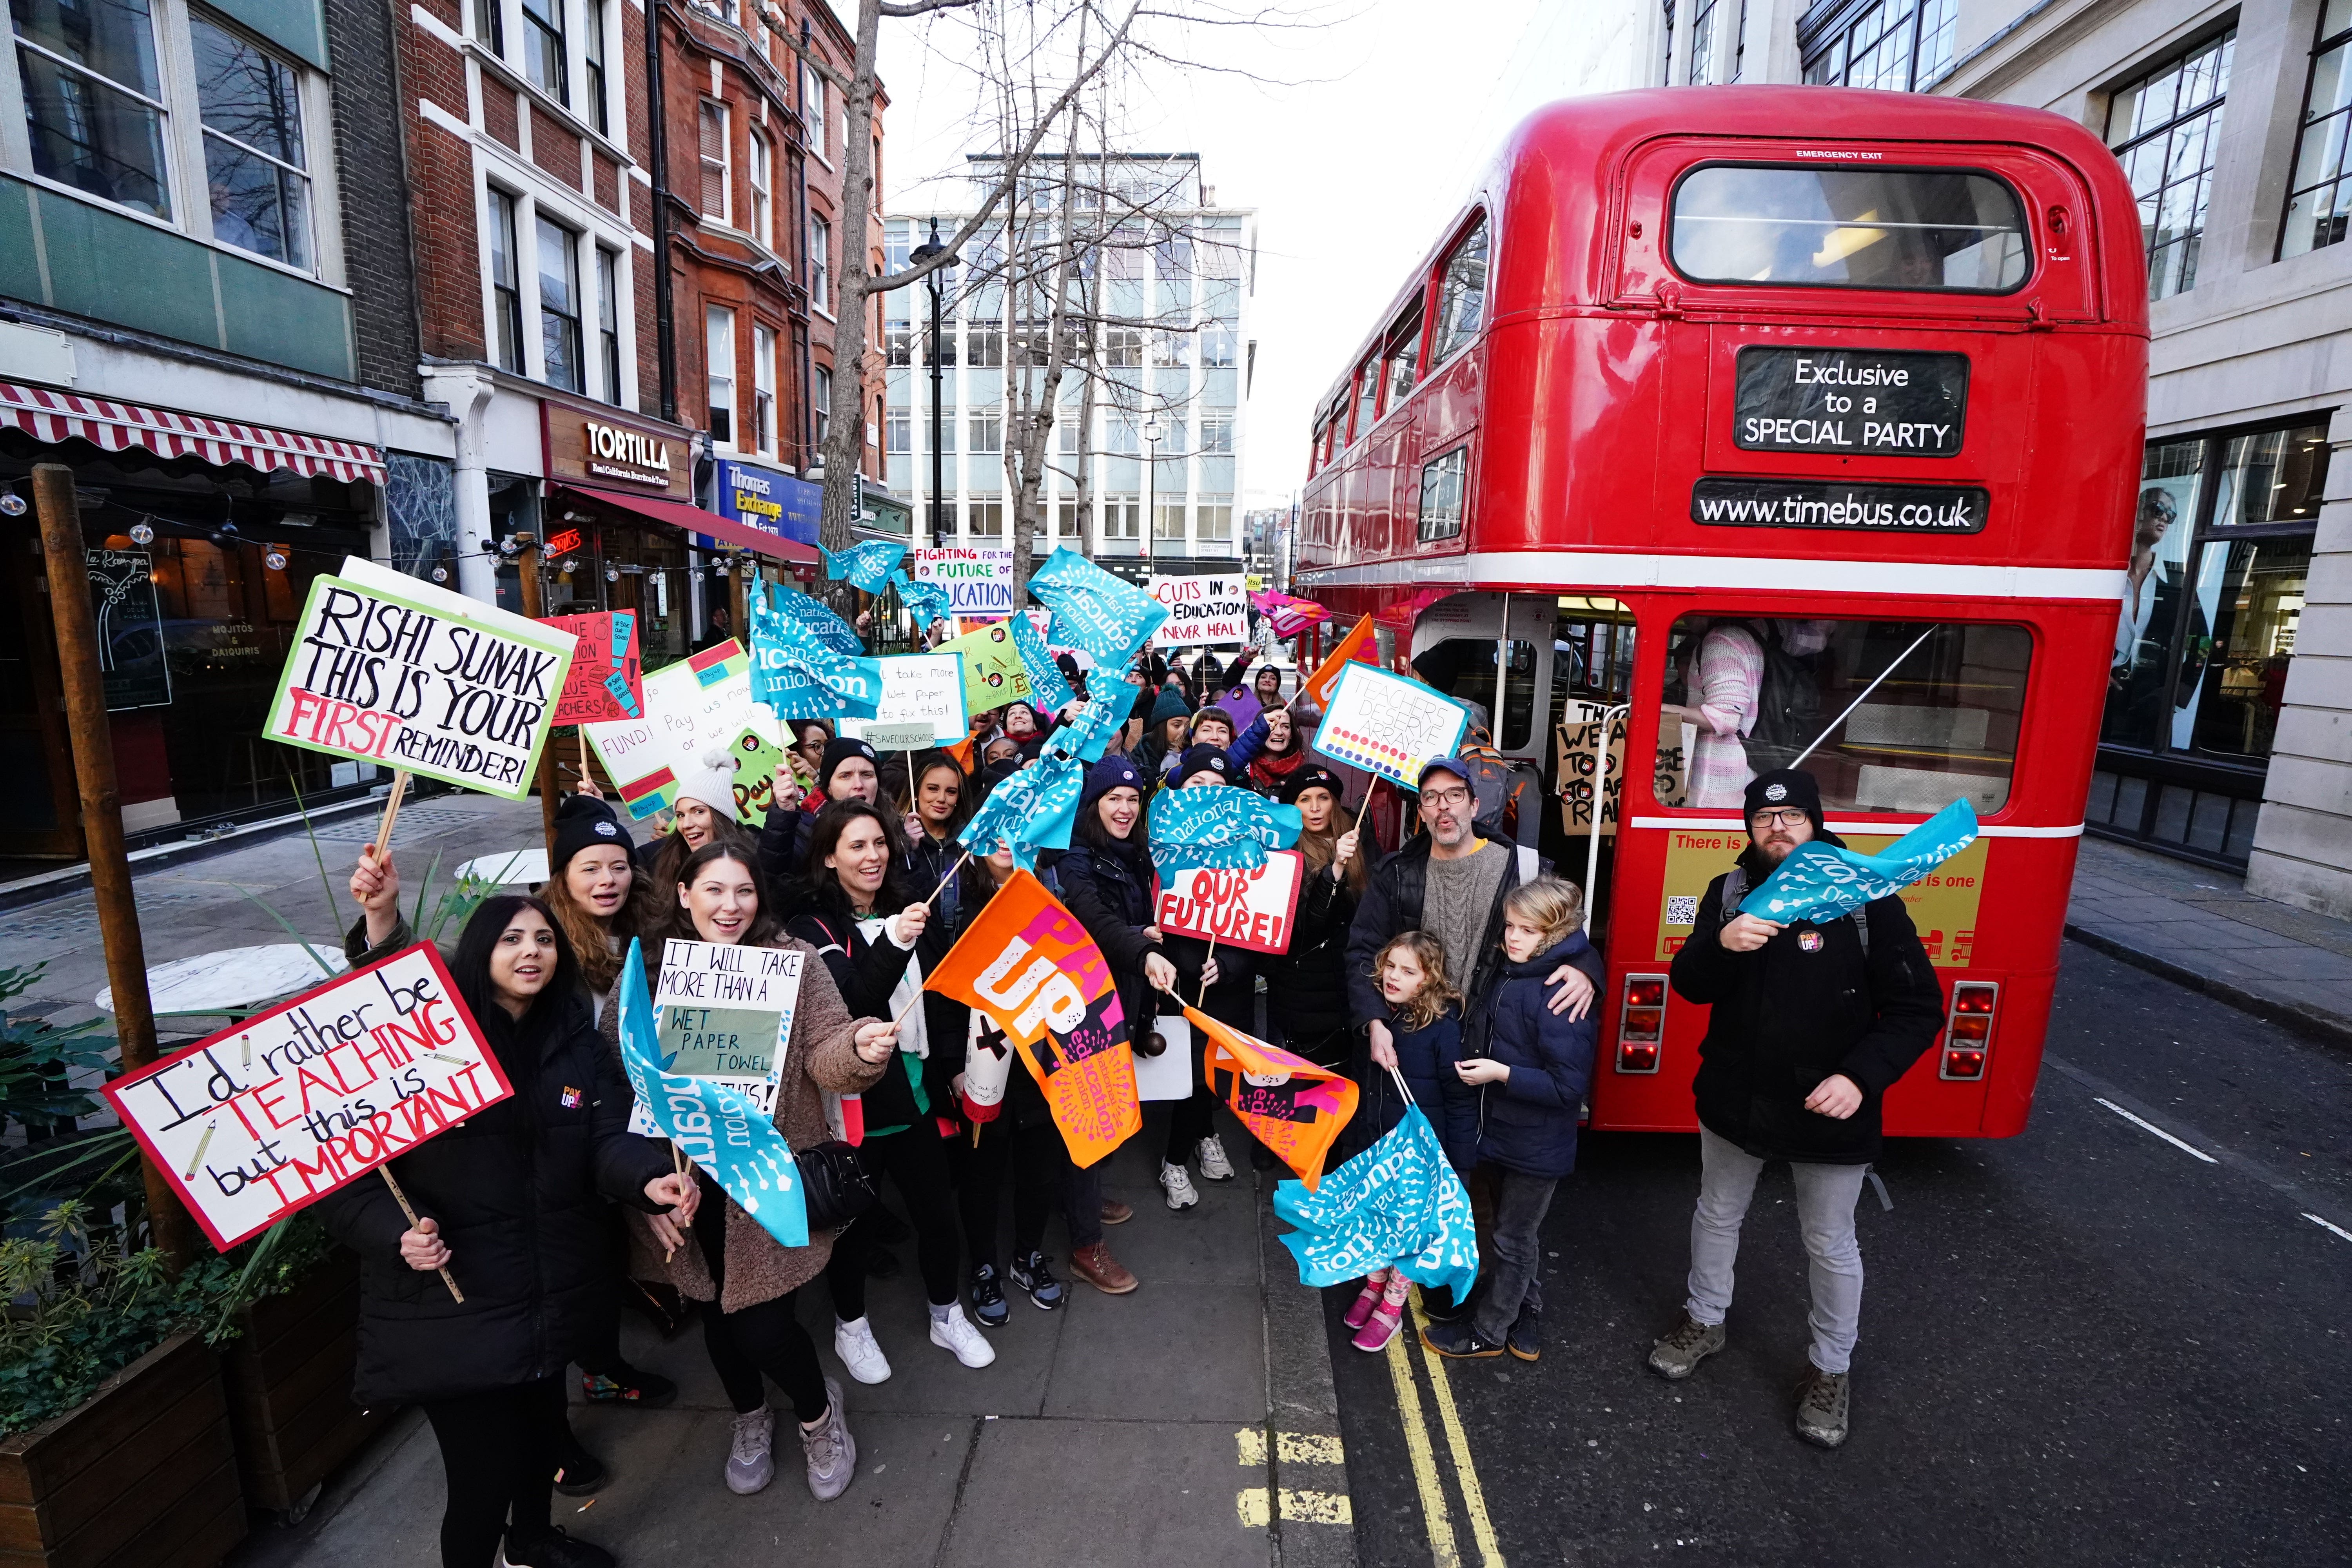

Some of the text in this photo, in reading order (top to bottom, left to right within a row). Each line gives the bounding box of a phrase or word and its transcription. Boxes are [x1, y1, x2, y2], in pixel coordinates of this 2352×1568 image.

[1796, 150, 1859, 159] EMERGENCY
[1795, 359, 1908, 386] Exclusive
[1825, 394, 1877, 414] to a
[588, 422, 670, 471] TORTILLA
[1744, 418, 1951, 449] SPECIAL PARTY
[592, 463, 605, 474] Real
[605, 465, 631, 479] California
[631, 471, 652, 483] Burritos
[655, 476, 669, 486] Tacos
[728, 466, 770, 495] Thomas
[736, 490, 782, 523] Exchange
[1699, 493, 1971, 528] www.timebus.co.uk
[768, 526, 779, 536] 1978
[916, 548, 1012, 561] FIGHTING FOR THE
[936, 563, 1012, 577] FUTURE OF
[1158, 581, 1223, 604] CUTS IN
[1173, 602, 1245, 620] EDUCATION
[212, 625, 254, 634] MOJITOS
[1162, 625, 1201, 640] NEVER
[212, 646, 260, 657] DAIQUIRIS
[314, 586, 557, 707] RISHI SUNAK,
[896, 667, 922, 679] take
[989, 674, 997, 682] PAY
[1022, 644, 1052, 681] national
[303, 636, 542, 750] THIS IS YOUR
[986, 686, 1008, 701] #PAYUP
[1353, 673, 1448, 728] TEACHERS
[603, 684, 751, 758] FUND! Pay us now
[881, 704, 948, 723] to fix this!
[1359, 699, 1442, 746] DESERVE
[281, 686, 526, 787] FIRST REMINDER!
[683, 709, 755, 750] or we will
[1358, 720, 1420, 757] ARRAYS
[1171, 797, 1242, 843] national
[1676, 834, 1740, 849] There is
[1192, 870, 1249, 911] OUR
[1927, 875, 1975, 888] is one
[1161, 893, 1283, 946] FUTURE!
[1800, 933, 1817, 941] PAY
[666, 941, 800, 978] IT WILL TAKE
[659, 970, 768, 1002] MORE THAN A
[671, 1008, 711, 1031] WET
[125, 970, 439, 1131] I'd rather be
[681, 1032, 740, 1051] PAPER
[201, 999, 456, 1140] TEACHING
[716, 1053, 771, 1072] TOWEL
[563, 1086, 581, 1097] PAY
[1071, 1029, 1116, 1142] education
[1074, 1070, 1091, 1110] union
[1097, 1052, 1116, 1106] national
[205, 1067, 426, 1197] but this is
[249, 1060, 482, 1219] IMPORTANT
